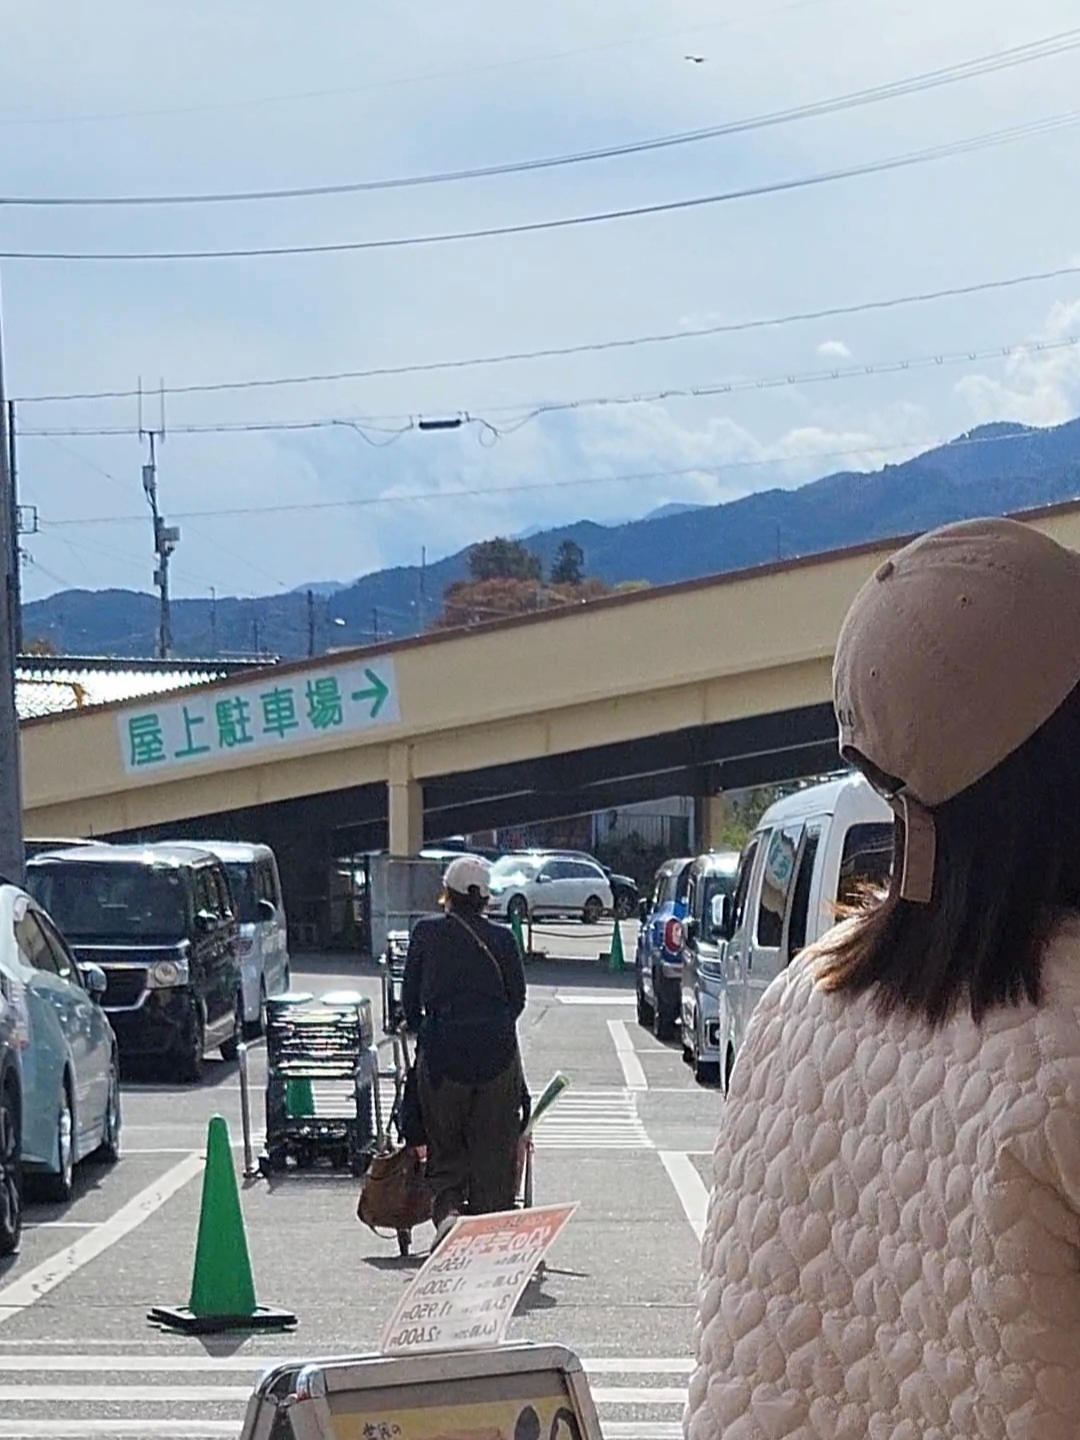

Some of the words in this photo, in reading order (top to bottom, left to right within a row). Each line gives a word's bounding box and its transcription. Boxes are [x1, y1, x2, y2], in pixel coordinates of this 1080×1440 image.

[128, 676, 343, 766] 屋上駐車場
